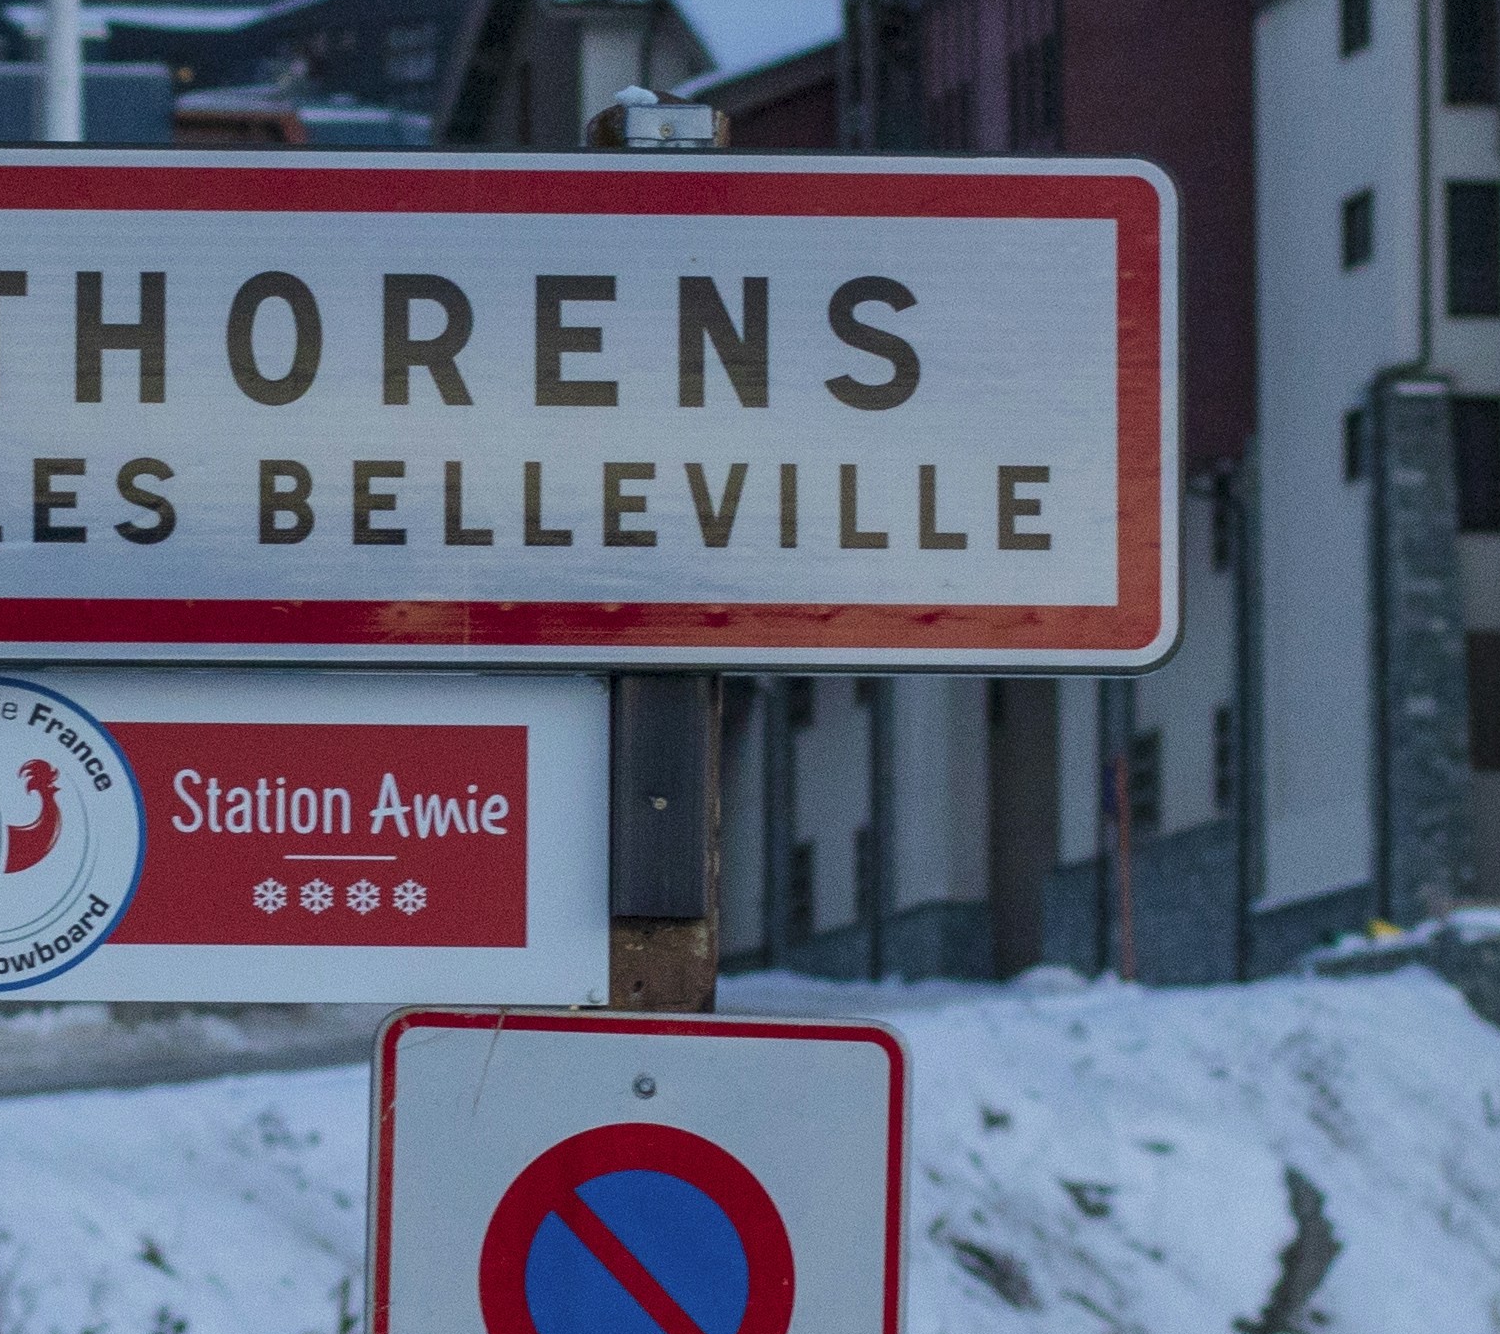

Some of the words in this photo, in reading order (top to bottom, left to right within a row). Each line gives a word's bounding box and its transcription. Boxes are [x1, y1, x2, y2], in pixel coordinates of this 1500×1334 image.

[258, 460, 1055, 553] BELLEVILLE
[28, 704, 113, 794] France
[172, 768, 351, 835] Station
[370, 773, 509, 838] Amie
